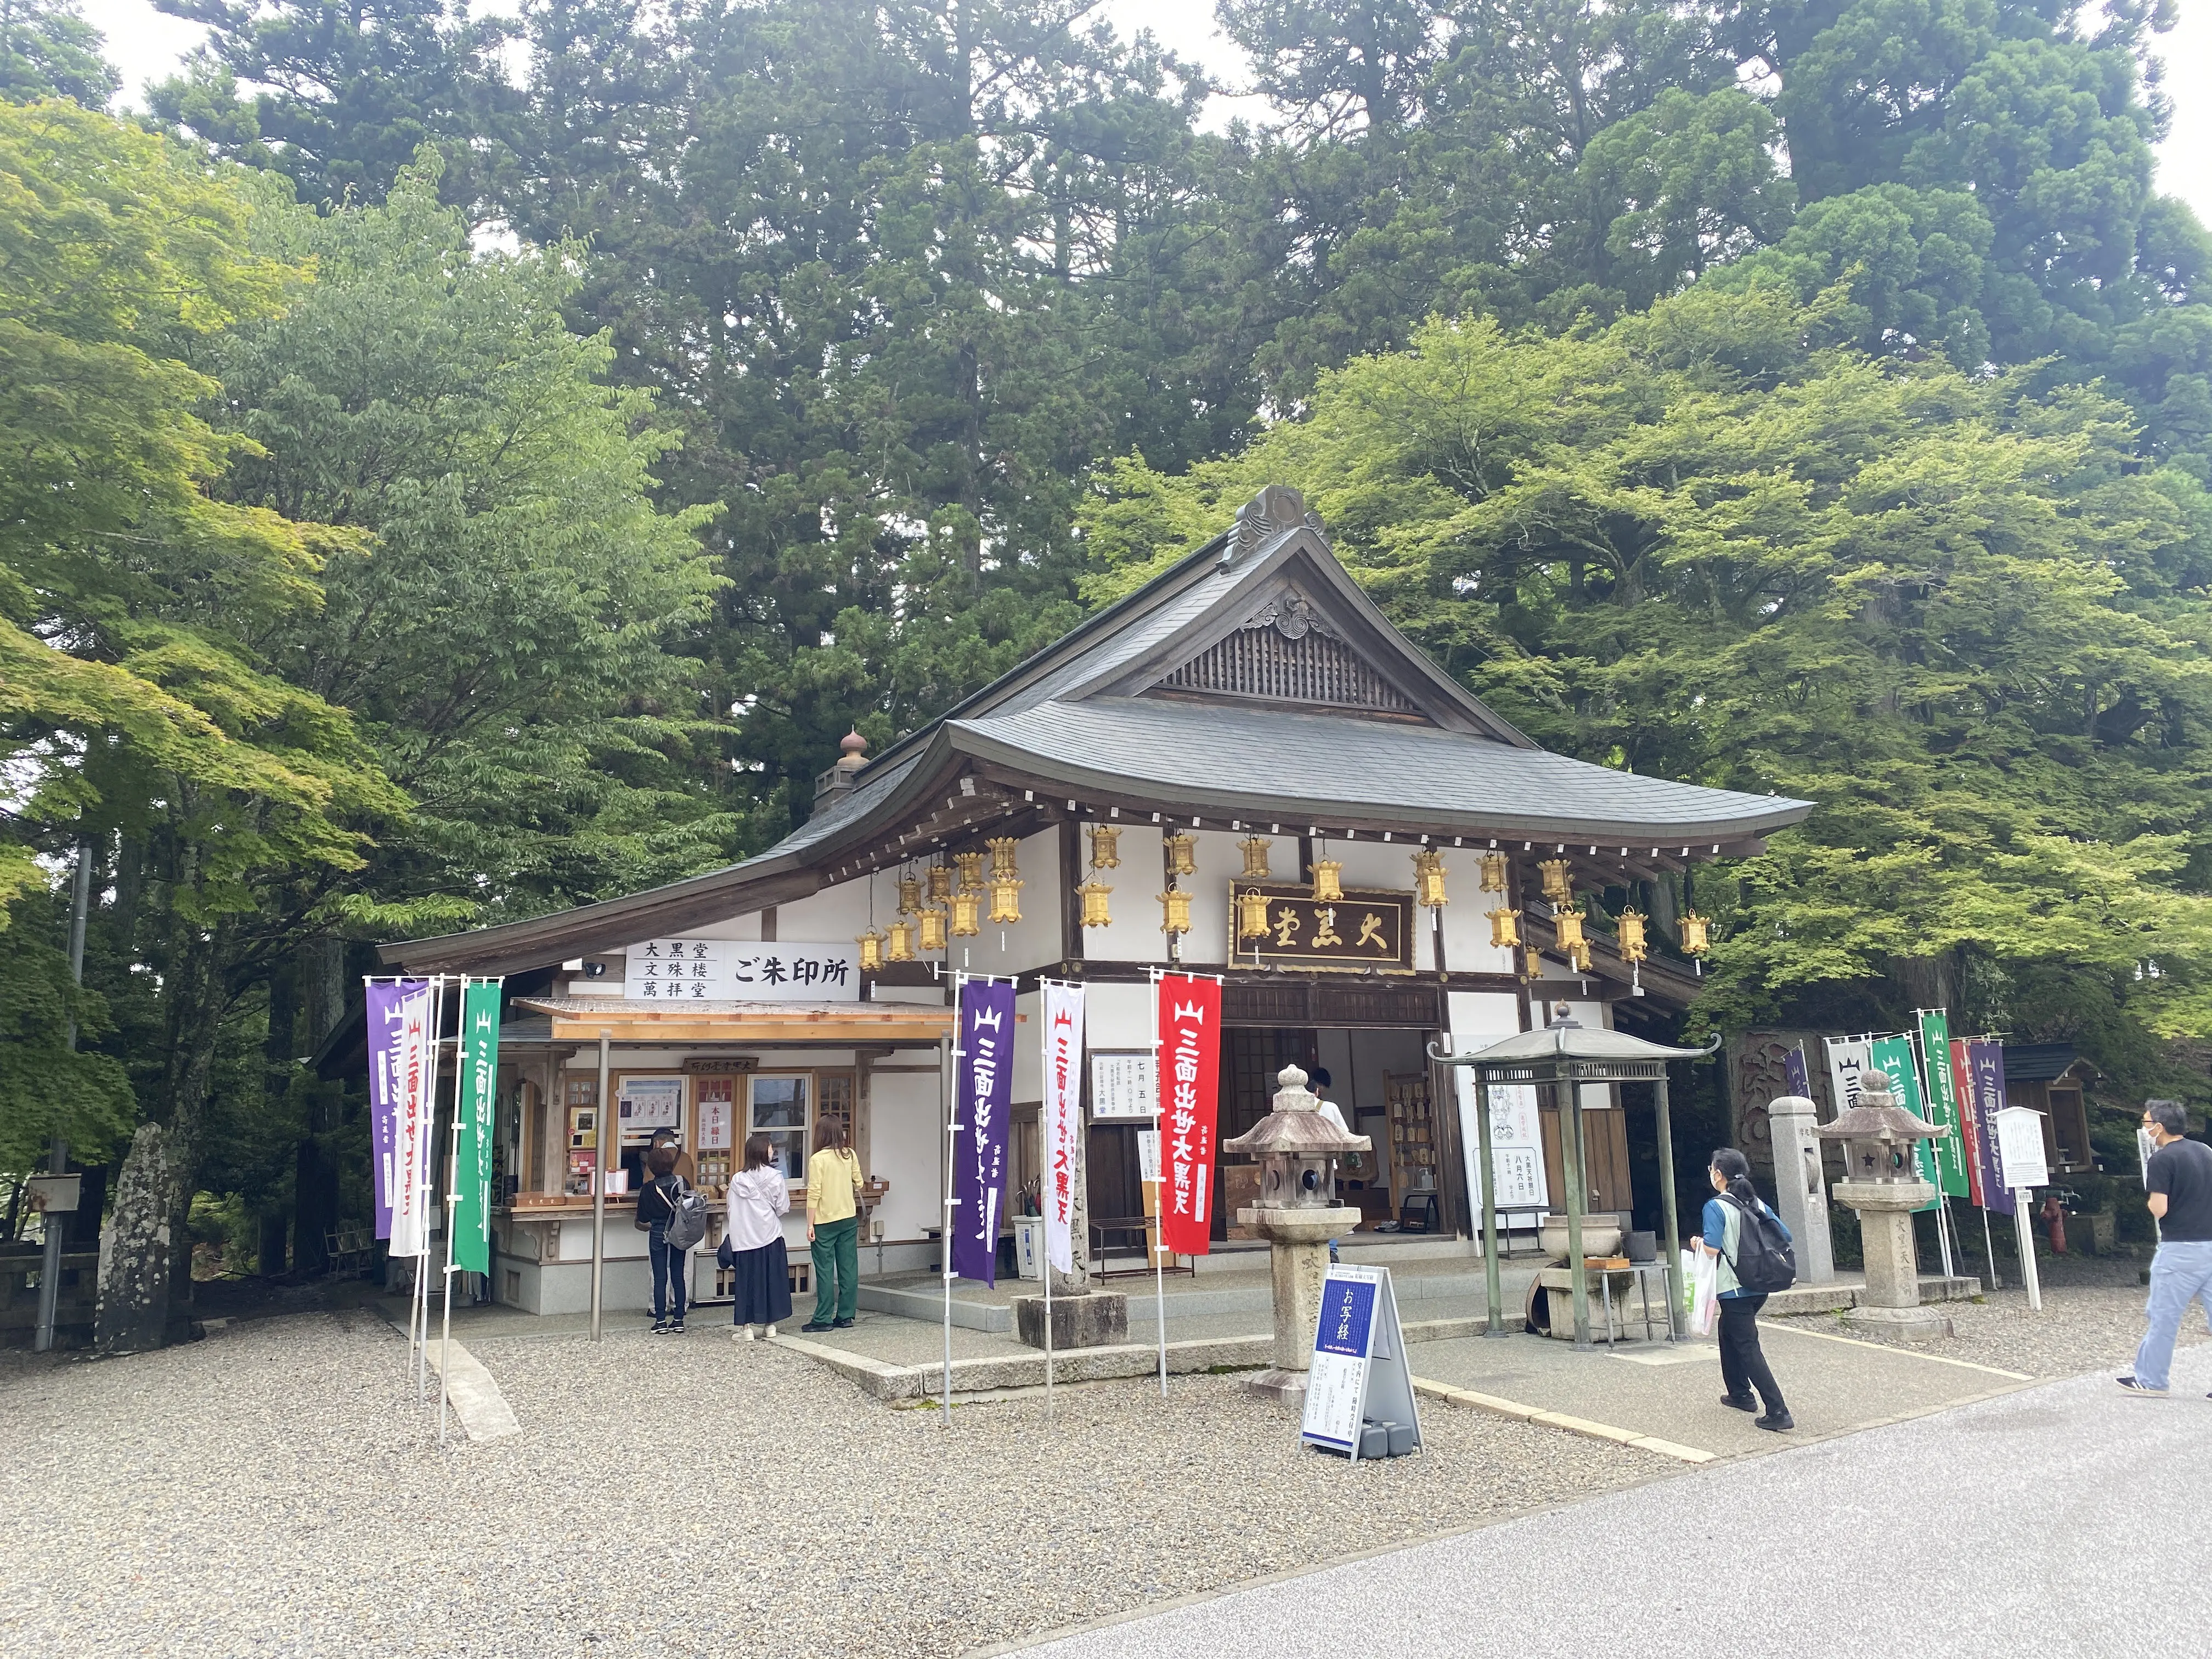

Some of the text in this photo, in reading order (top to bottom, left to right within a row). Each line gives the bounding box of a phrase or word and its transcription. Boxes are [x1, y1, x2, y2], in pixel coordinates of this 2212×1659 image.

[644, 942, 708, 959] 大黒堂
[644, 962, 707, 978] 文殊楼
[736, 956, 849, 986] ご朱印所
[643, 981, 707, 998] 萬拝堂
[711, 1106, 720, 1144] 本日縁日
[1516, 1155, 1524, 1190] 八月六日
[1336, 1288, 1353, 1340] お写経
